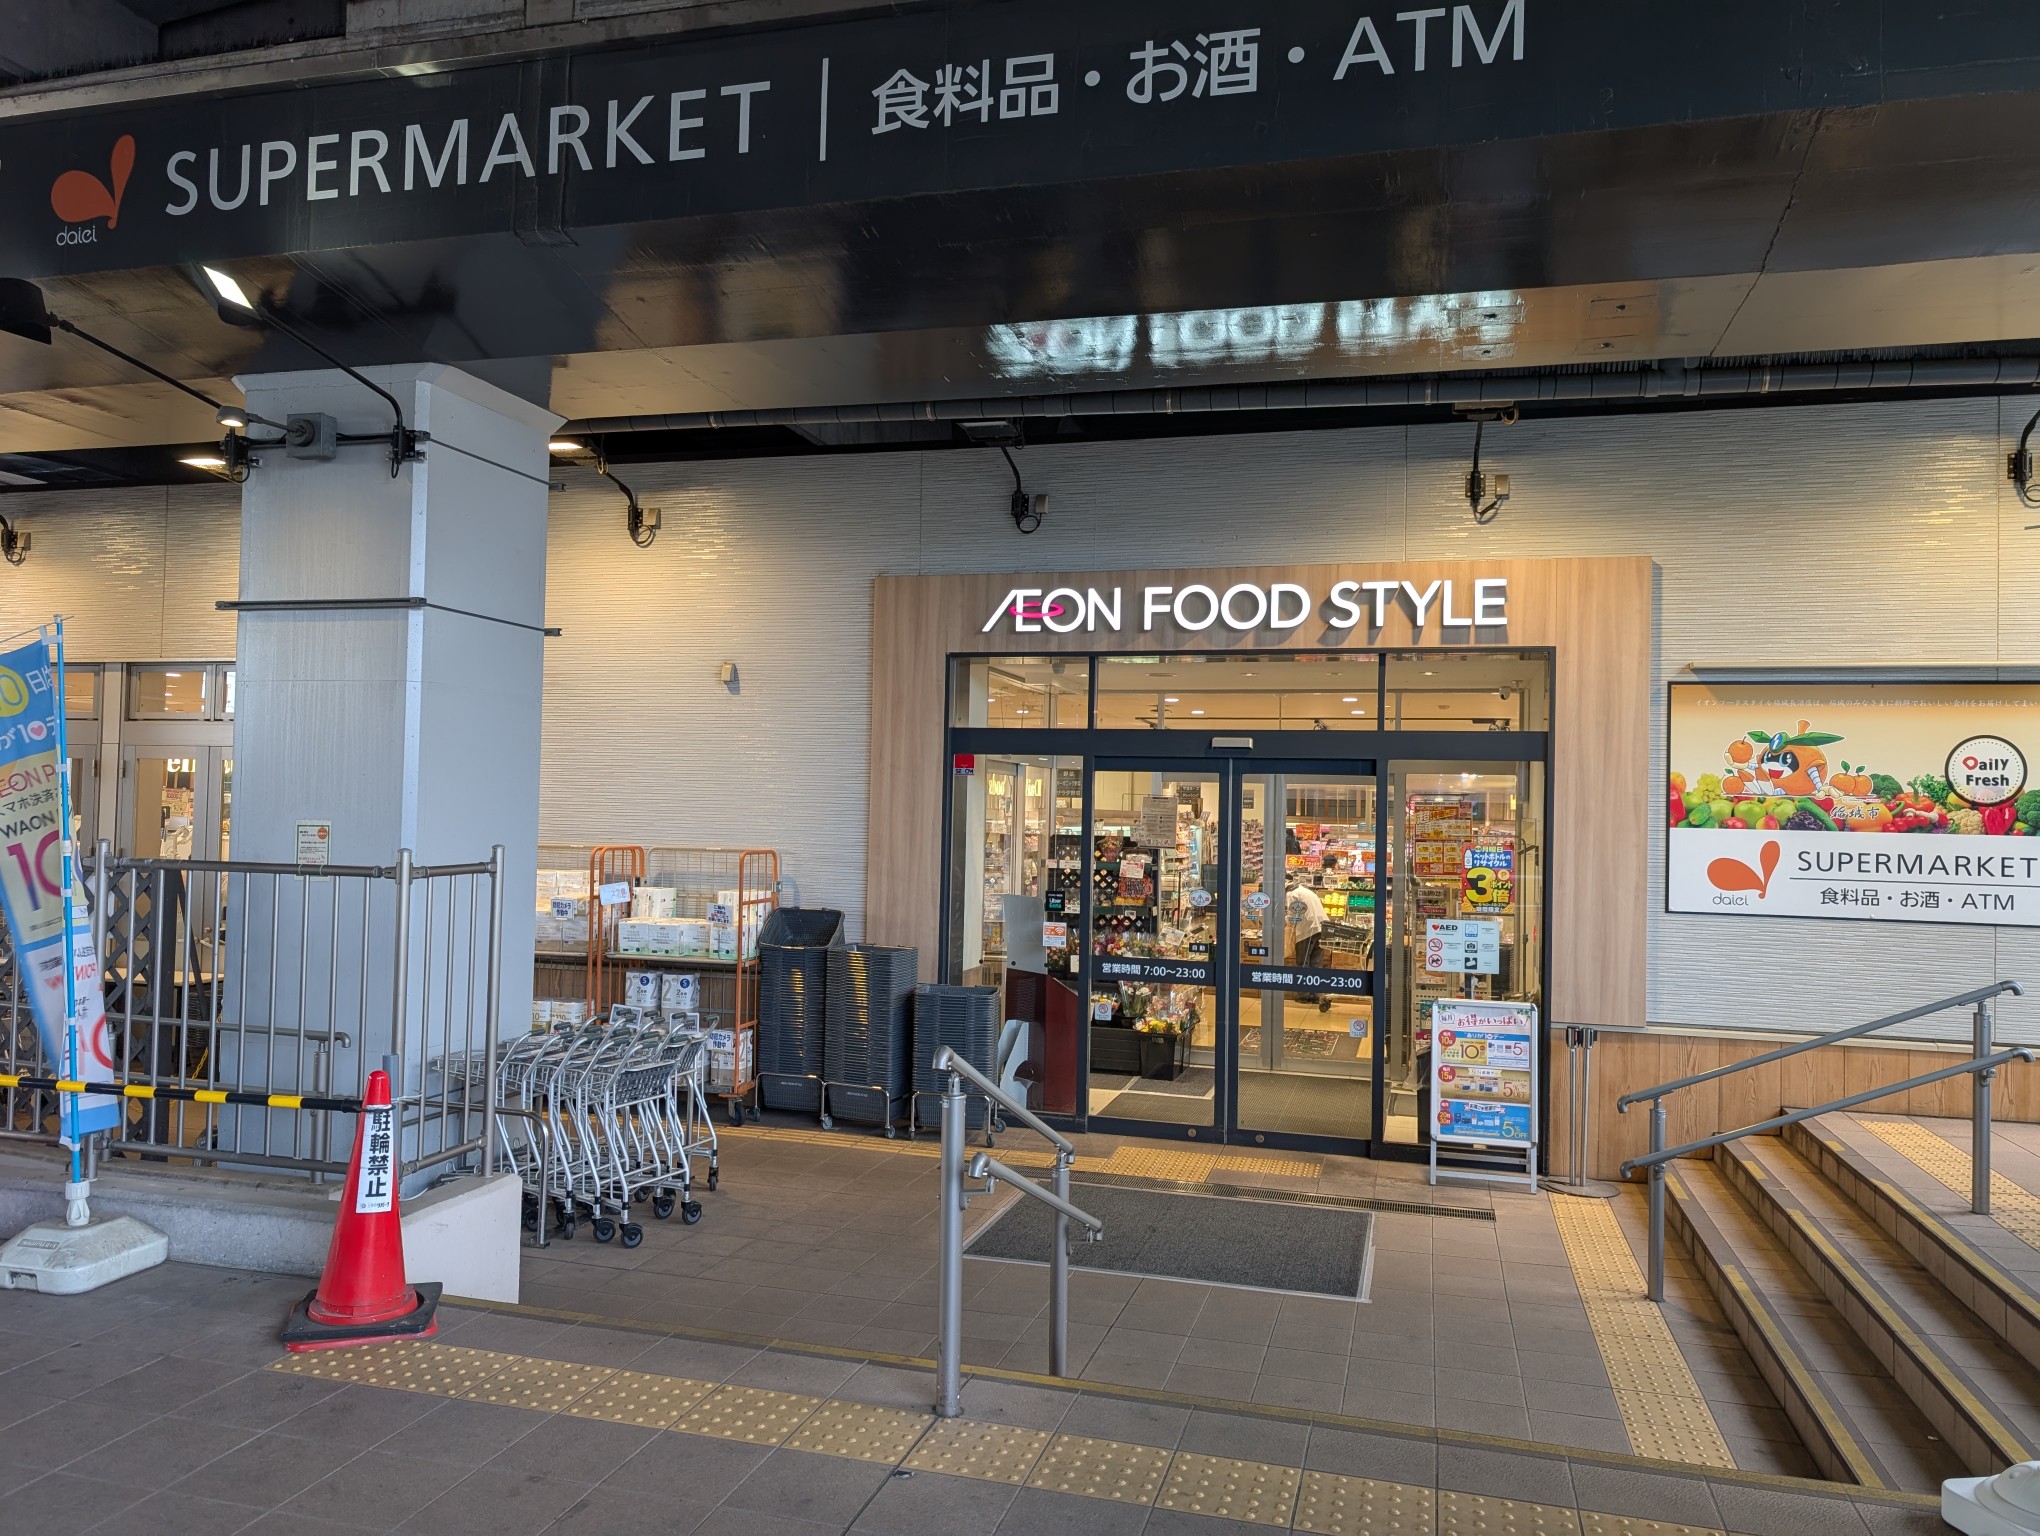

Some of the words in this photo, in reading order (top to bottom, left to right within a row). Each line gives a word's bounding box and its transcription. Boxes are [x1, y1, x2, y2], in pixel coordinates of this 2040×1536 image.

[165, 80, 771, 217] SUPERMARKET
[56, 225, 98, 247] daiei
[1143, 583, 1312, 632] FOOD
[1328, 578, 1509, 630] STYLE
[1966, 774, 2010, 786] Fresh
[1797, 850, 2038, 879] SUPERMARKET
[1466, 867, 1497, 903] 3
[1712, 892, 1749, 906] daiei
[1102, 963, 1141, 976] 営業時間
[1251, 971, 1293, 985] 営業時間
[1503, 1081, 1513, 1098] 5
[1502, 1121, 1514, 1138] 5
[365, 1110, 391, 1198] 駐輪禁止
